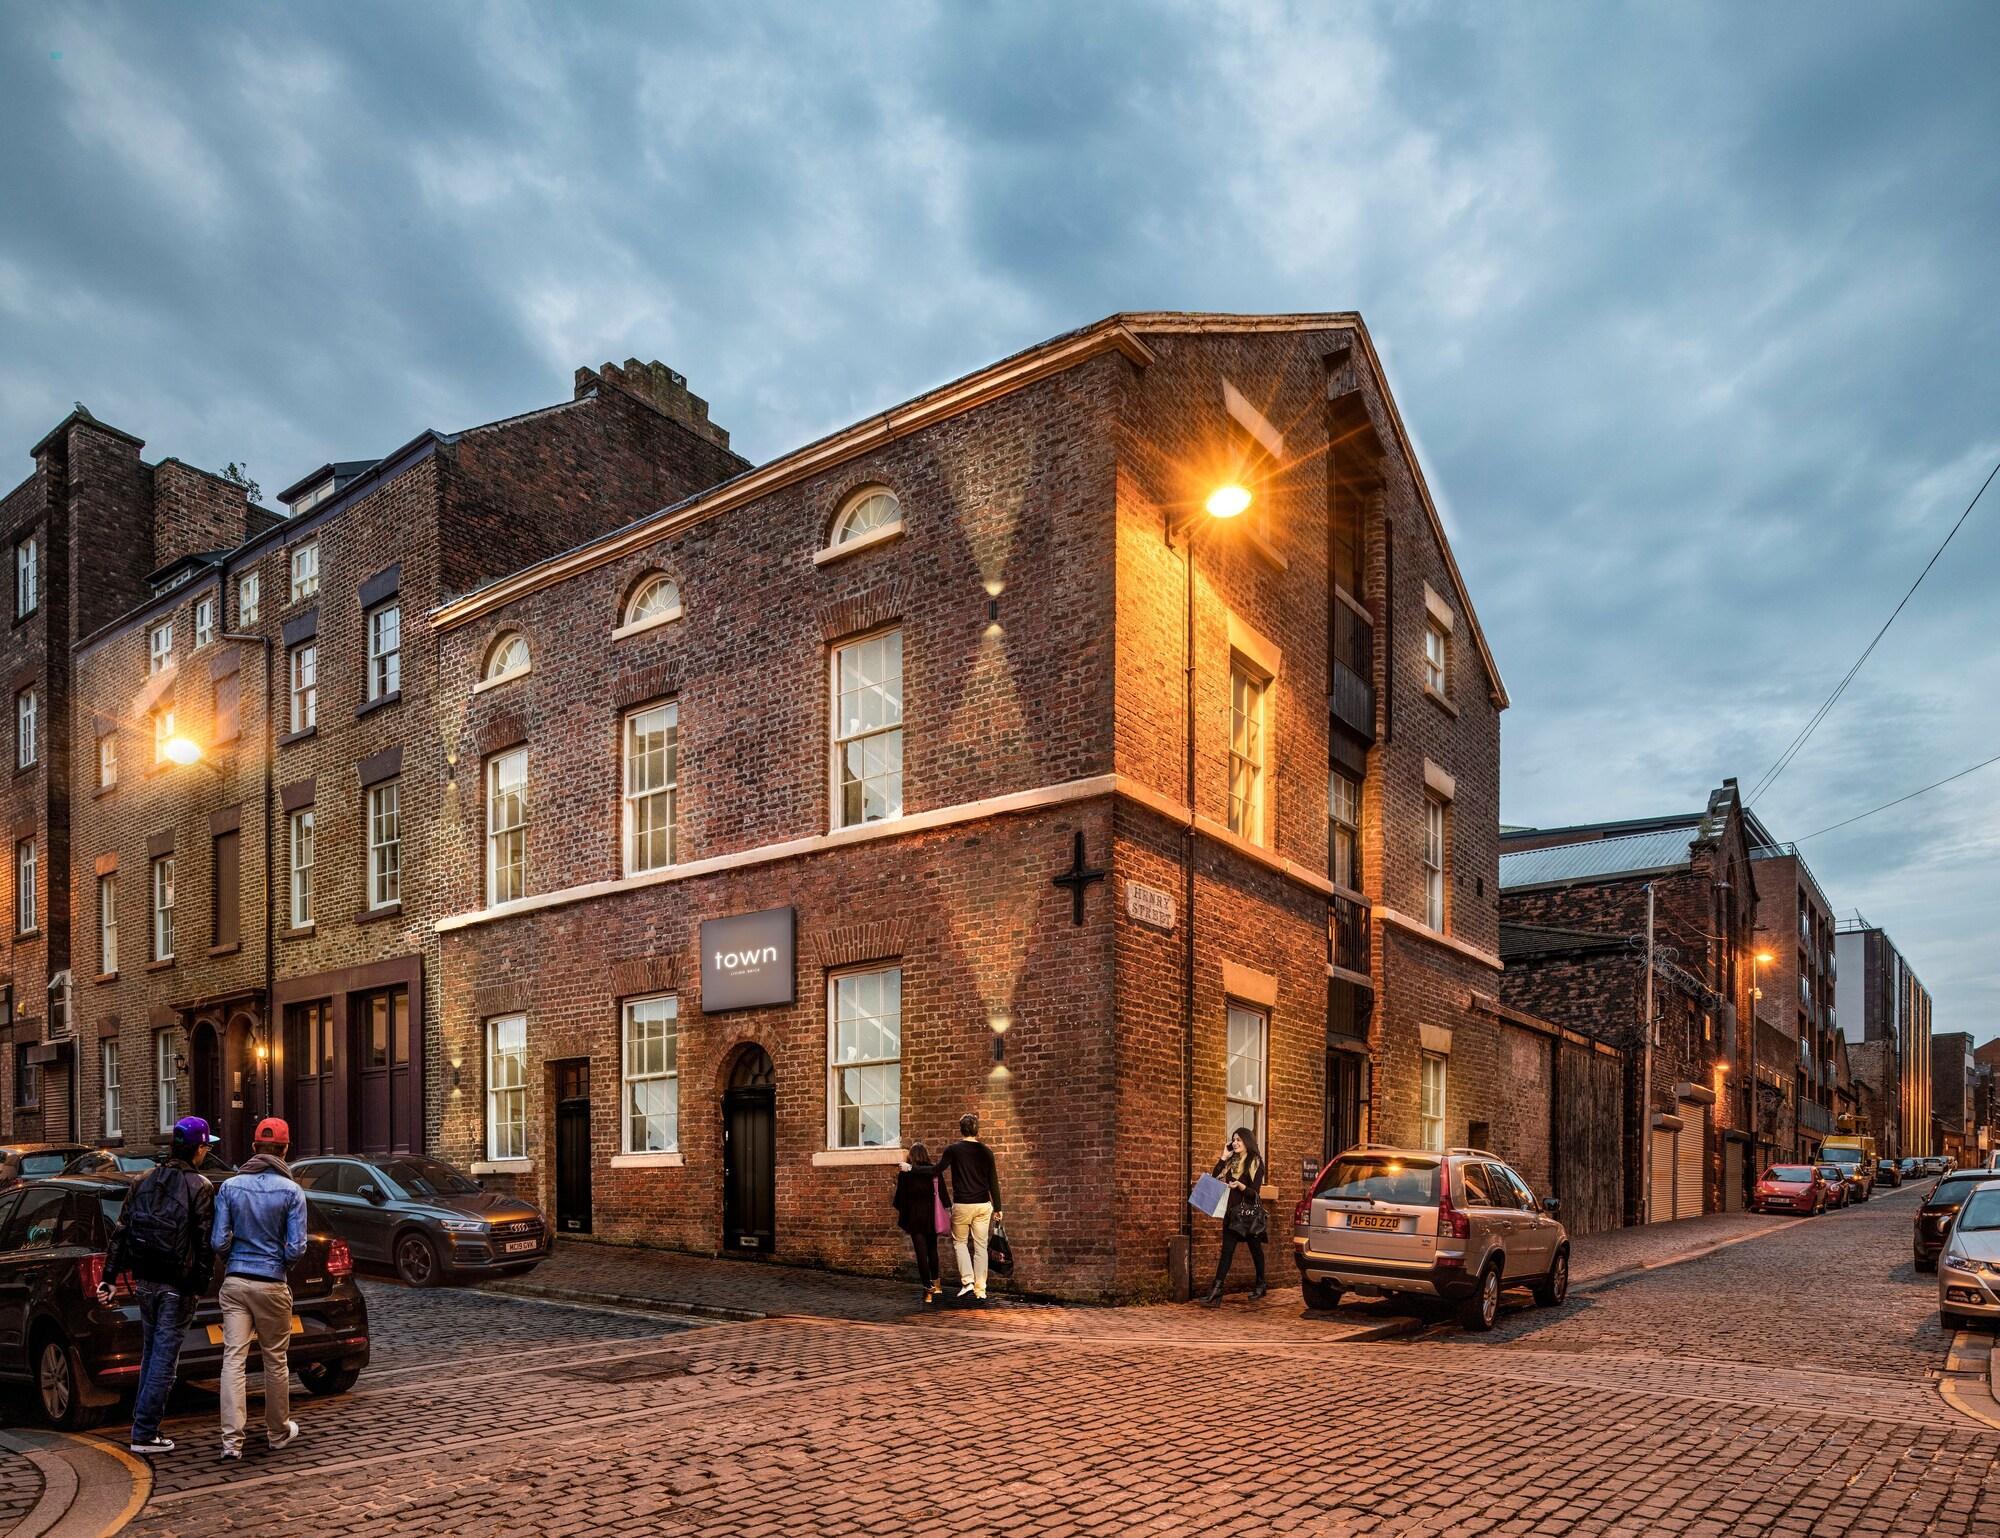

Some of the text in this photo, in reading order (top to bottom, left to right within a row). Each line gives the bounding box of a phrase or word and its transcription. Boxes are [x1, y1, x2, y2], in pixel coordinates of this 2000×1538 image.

[1133, 887, 1169, 910] HENRY
[1132, 902, 1172, 925] STREET
[714, 946, 777, 970] town
[1352, 1215, 1399, 1229] AF60 ZZD
